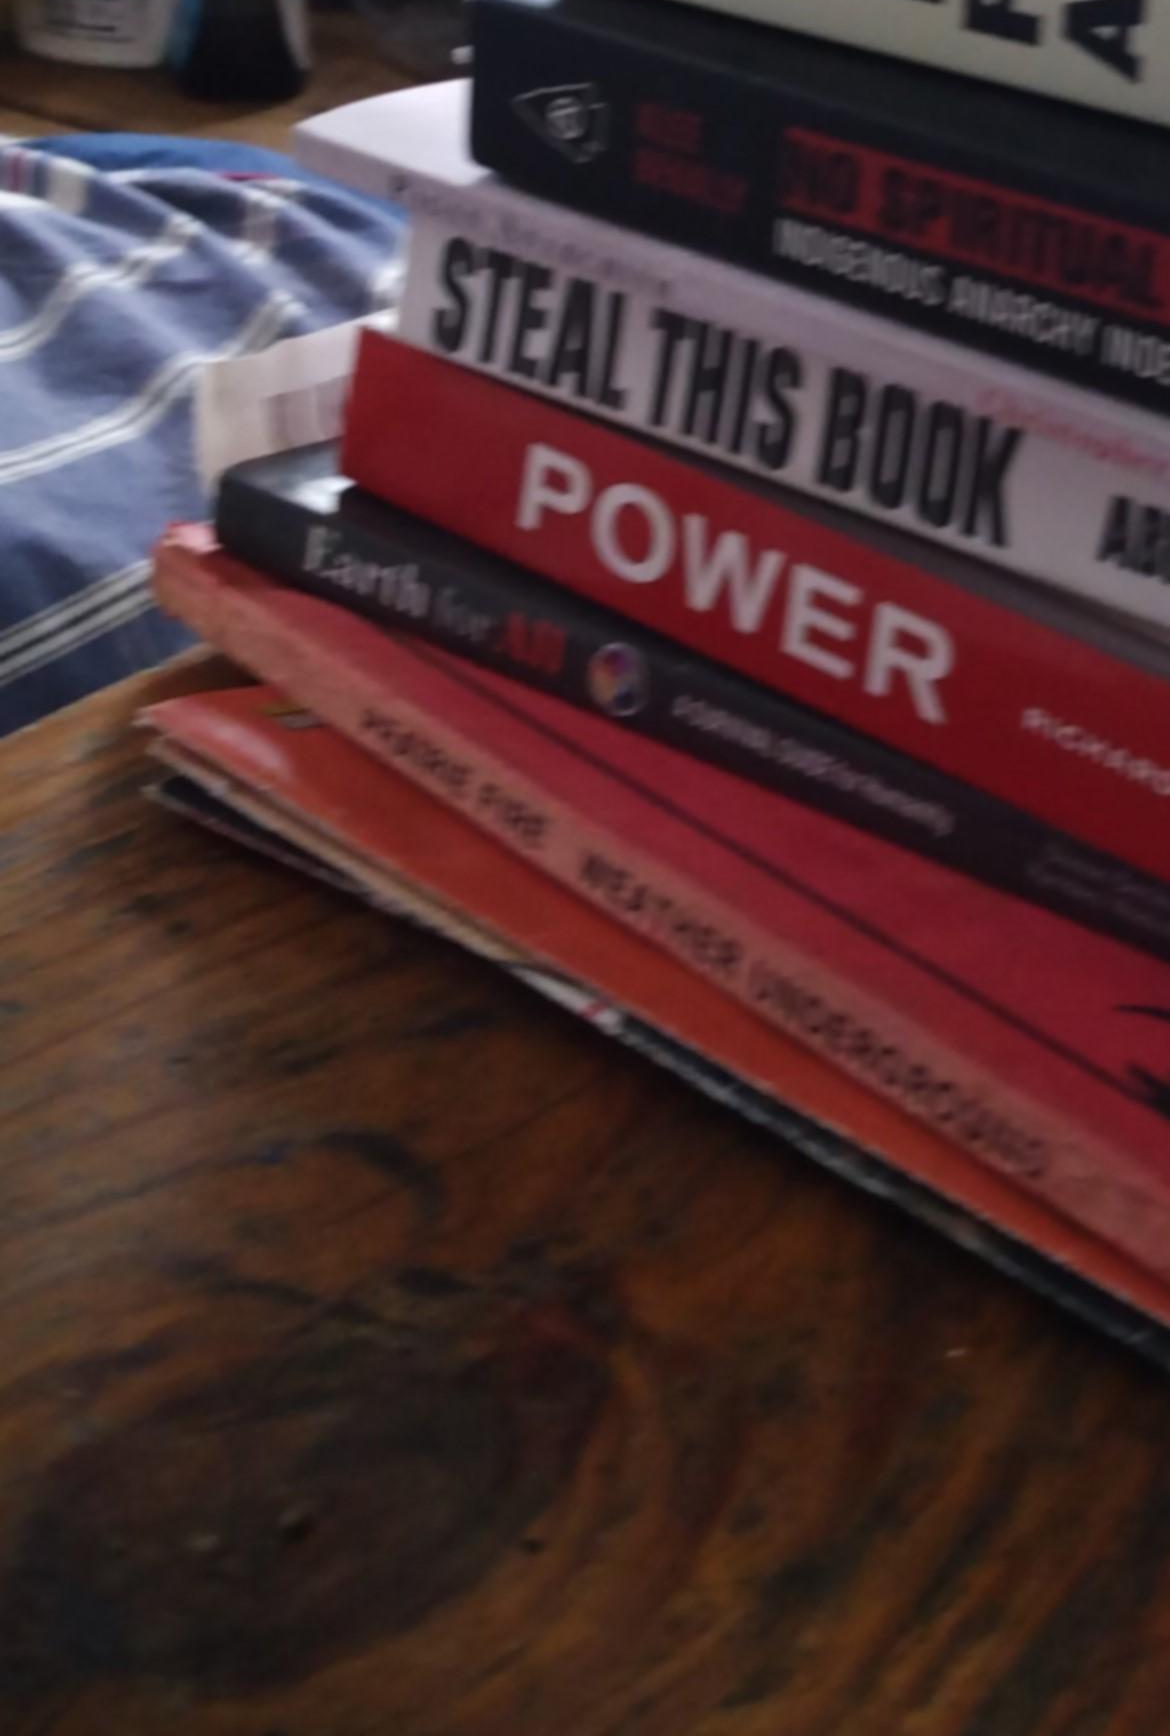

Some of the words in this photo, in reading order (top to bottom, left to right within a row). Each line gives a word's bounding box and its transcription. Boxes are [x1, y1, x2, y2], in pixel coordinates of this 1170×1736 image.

[880, 164, 1162, 310] SPIRITUAL
[432, 236, 626, 412] STEAL
[648, 308, 806, 470] THIS
[814, 367, 1024, 549] BOOK
[303, 525, 432, 620] Earth
[515, 441, 957, 726] POWER
